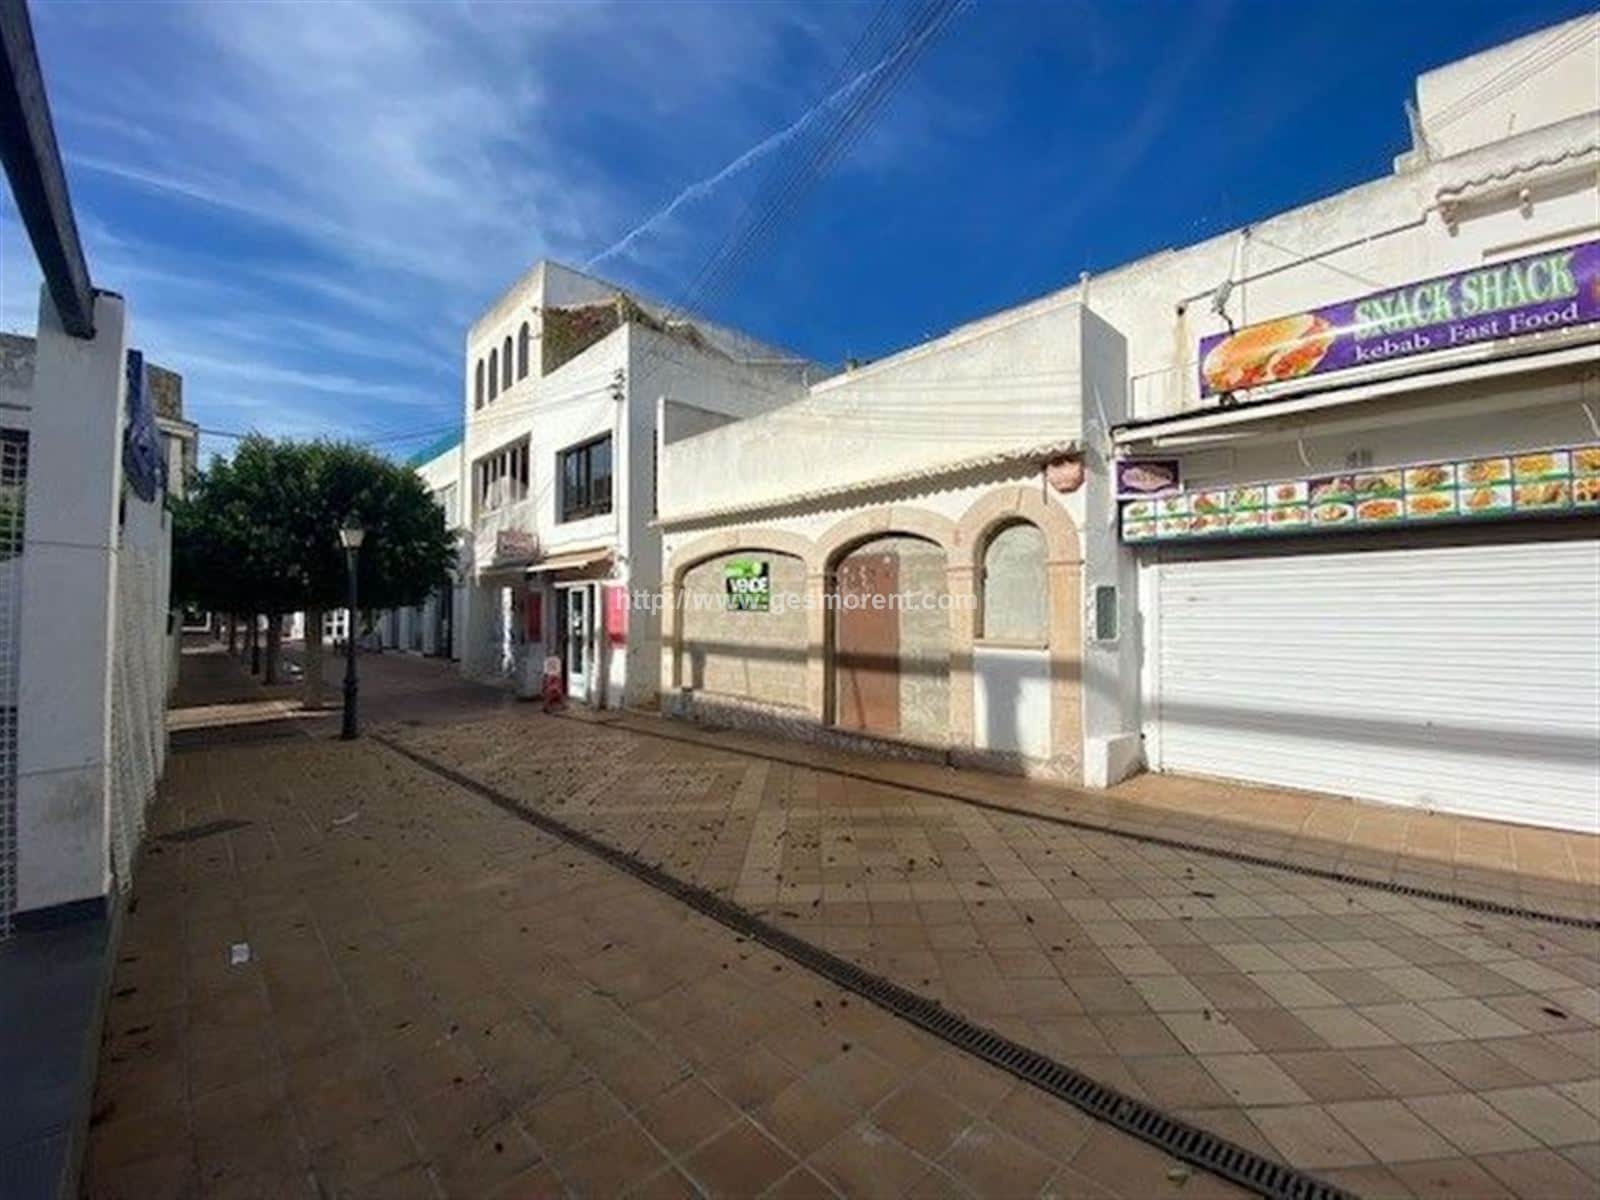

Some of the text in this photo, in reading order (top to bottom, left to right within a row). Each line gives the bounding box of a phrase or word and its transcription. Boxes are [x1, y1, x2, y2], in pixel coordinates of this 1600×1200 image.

[1355, 254, 1578, 340] SNACK SHACK
[1356, 303, 1579, 362] kebab Fast Food
